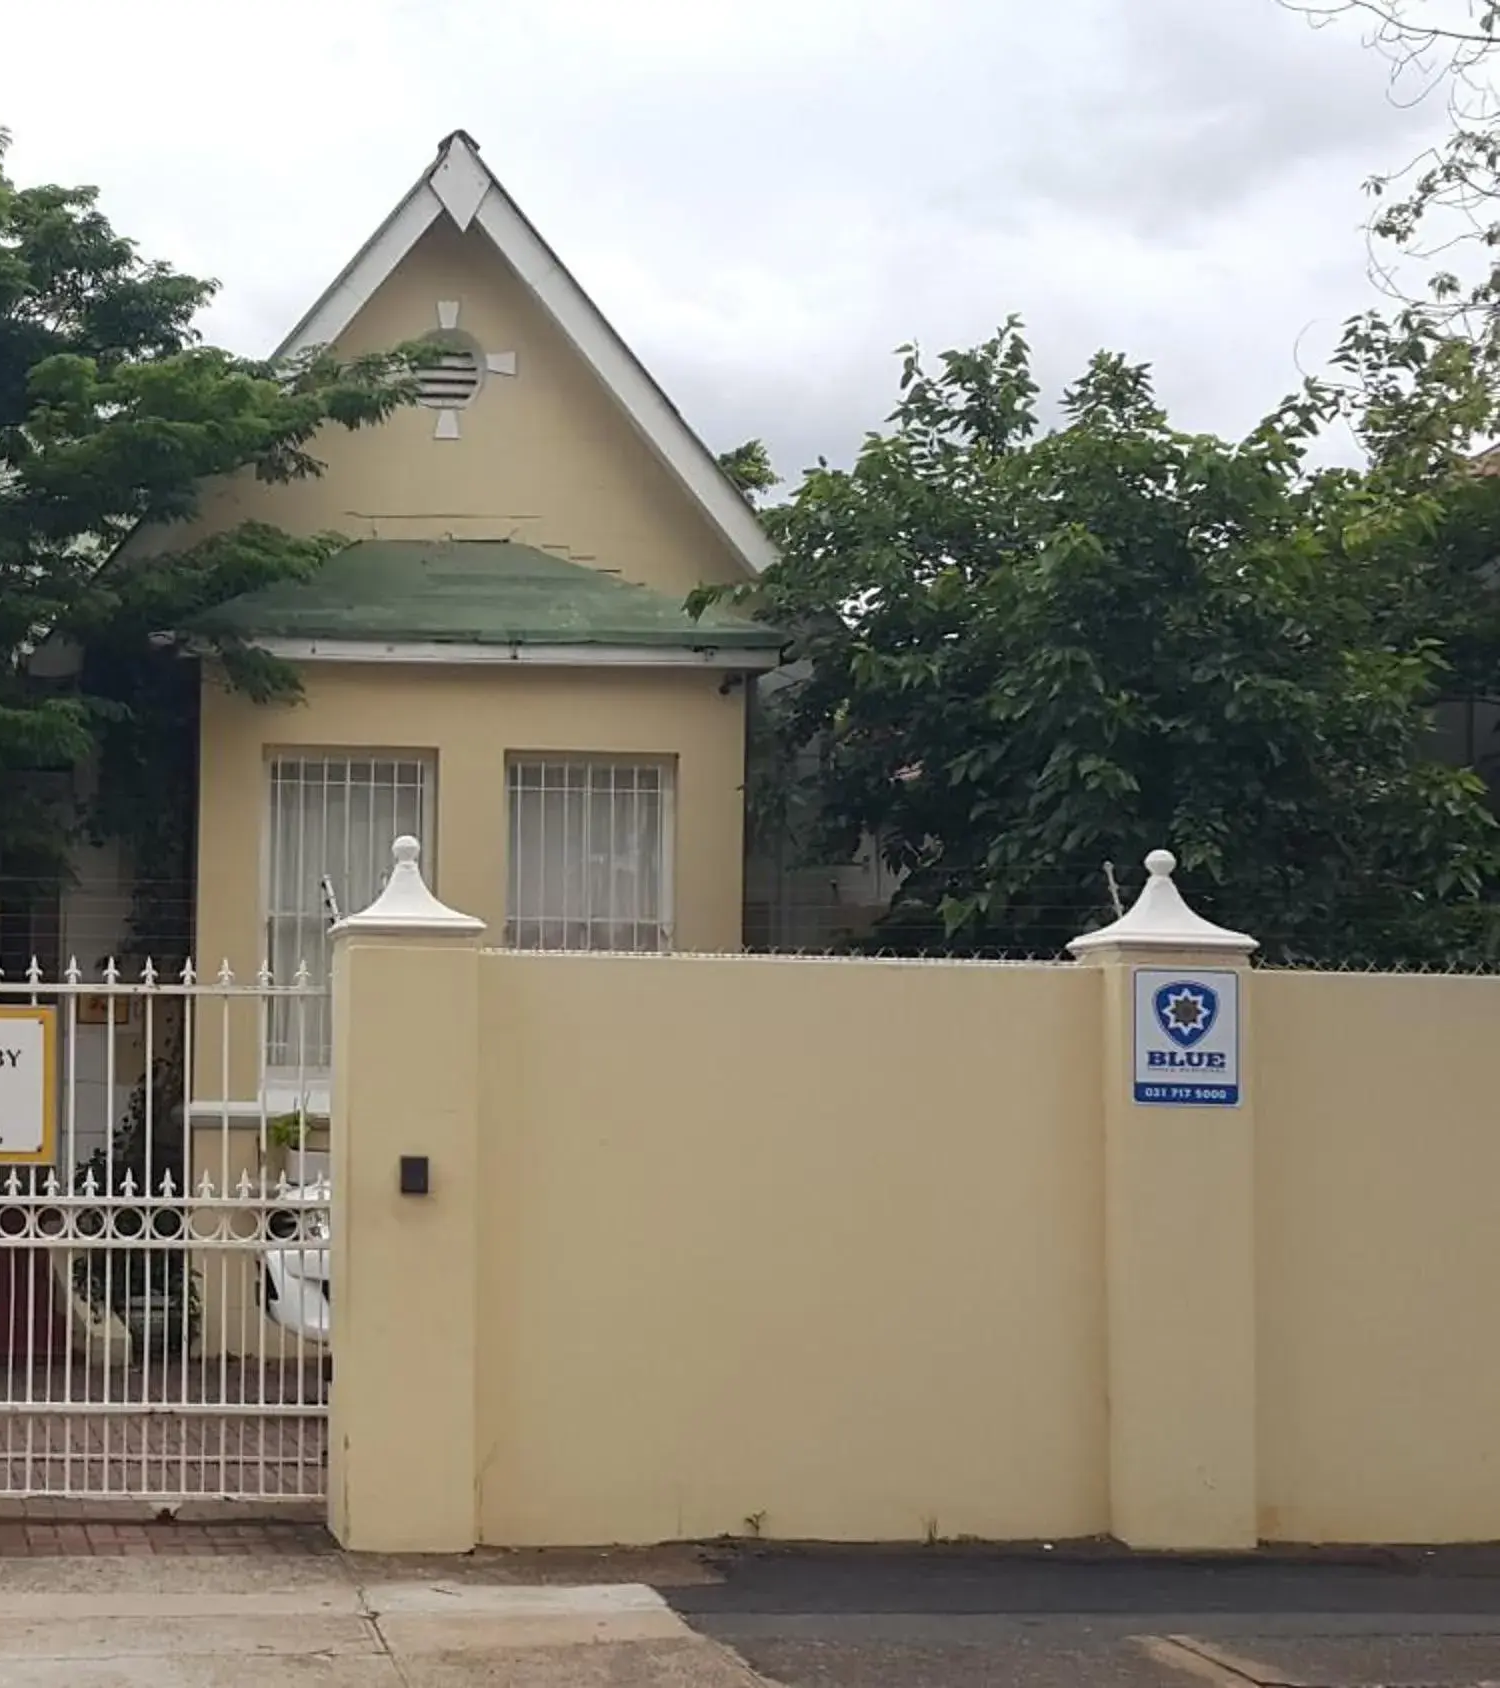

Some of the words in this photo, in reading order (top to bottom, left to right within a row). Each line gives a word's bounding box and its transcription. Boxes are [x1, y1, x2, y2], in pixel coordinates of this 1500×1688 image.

[1148, 1051, 1226, 1068] BLUE
[1145, 1087, 1167, 1098] 031
[1170, 1088, 1192, 1099] 717
[1195, 1088, 1227, 1099] 5000
